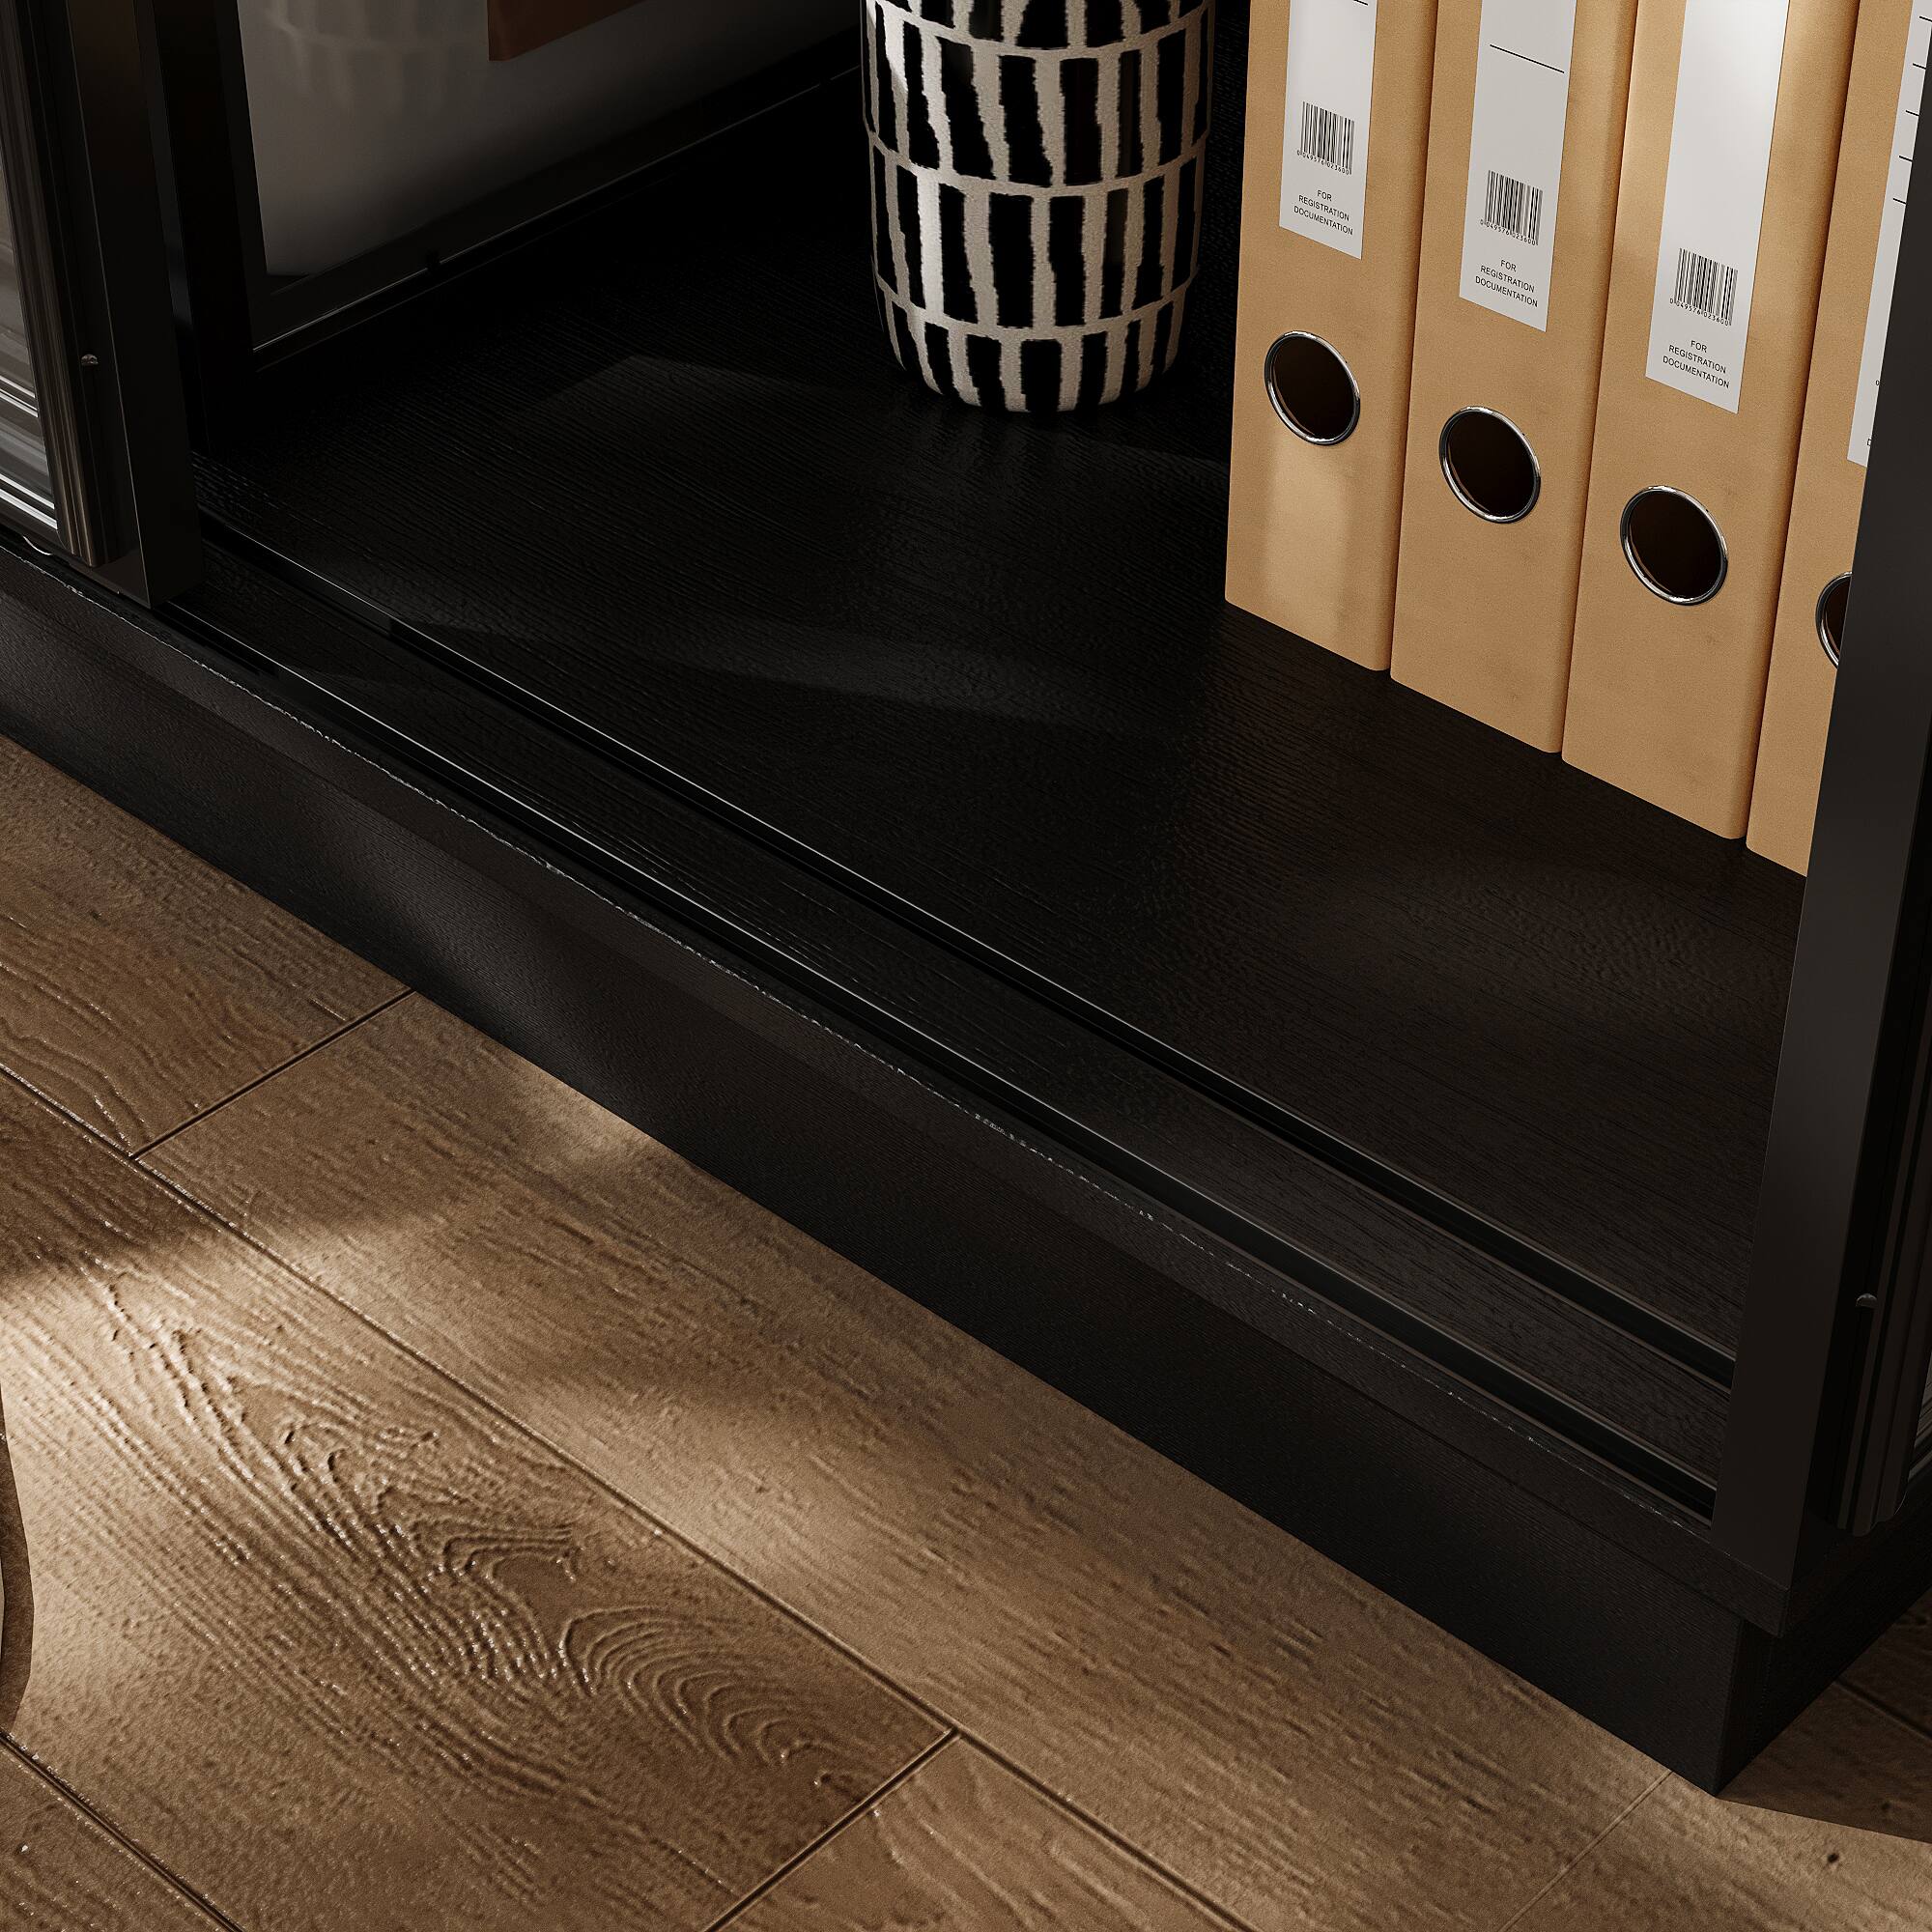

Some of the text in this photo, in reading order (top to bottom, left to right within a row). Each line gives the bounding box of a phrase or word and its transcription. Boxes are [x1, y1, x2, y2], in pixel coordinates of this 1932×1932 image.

[1298, 194, 1350, 221] REGISTRATION
[1317, 189, 1332, 202] FOR
[1293, 205, 1352, 235] DOCUMENTATION
[1480, 265, 1535, 293] REGISTRATION
[1500, 259, 1517, 272] FOR
[1475, 275, 1538, 307] DOCUMENTATION
[1668, 344, 1726, 374] REGISTRATION
[1690, 339, 1707, 353] FOR
[1662, 355, 1730, 388] DOCUMENTATION
